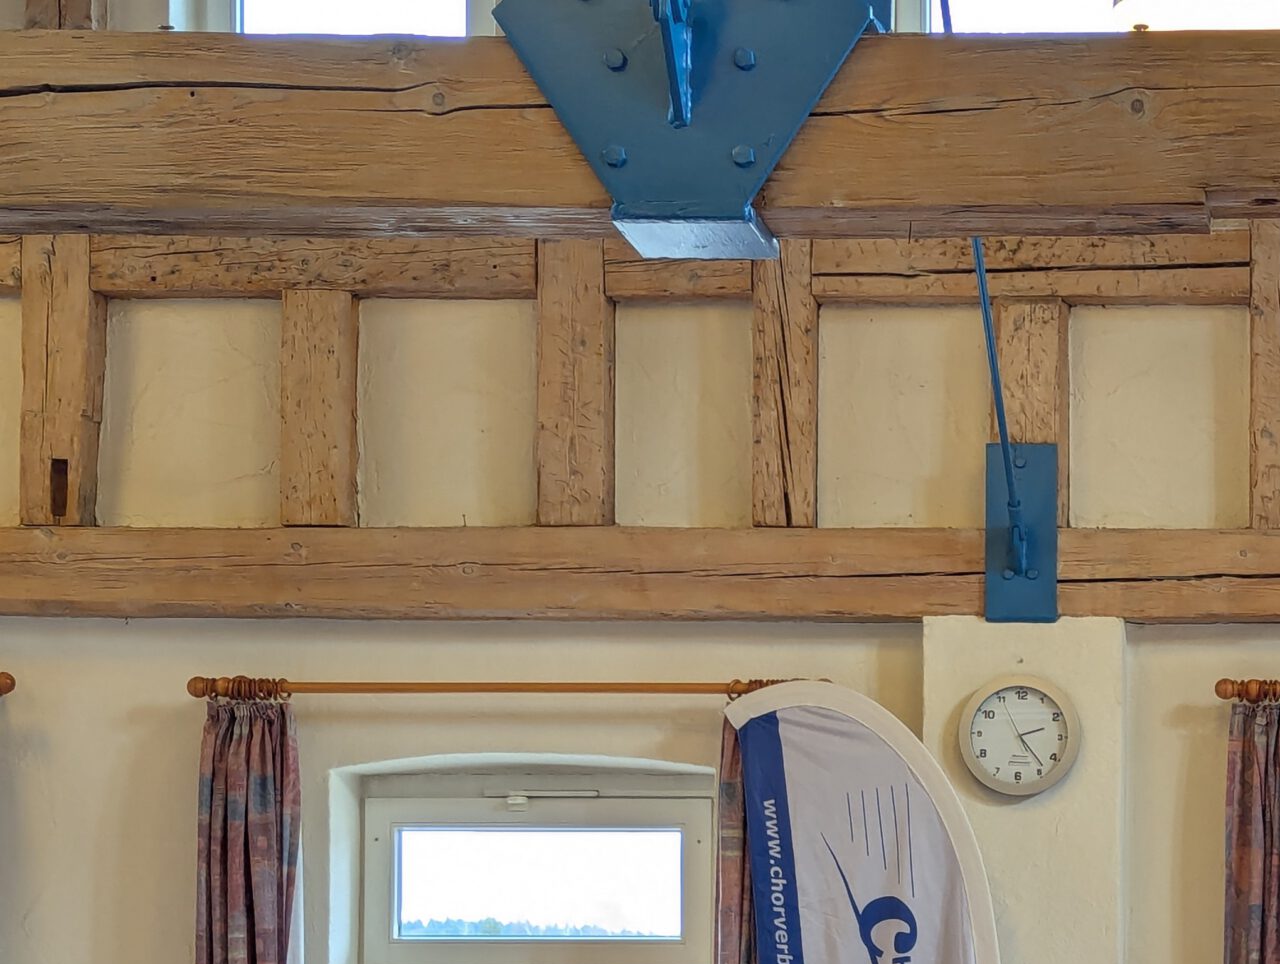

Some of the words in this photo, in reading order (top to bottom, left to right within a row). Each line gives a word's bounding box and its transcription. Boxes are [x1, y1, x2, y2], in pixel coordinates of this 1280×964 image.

[1015, 691, 1028, 700] 12
[982, 710, 995, 719] 10
[1052, 712, 1060, 721] 2
[980, 749, 987, 758] 8
[1049, 753, 1057, 762] 4
[1014, 772, 1022, 780] 6
